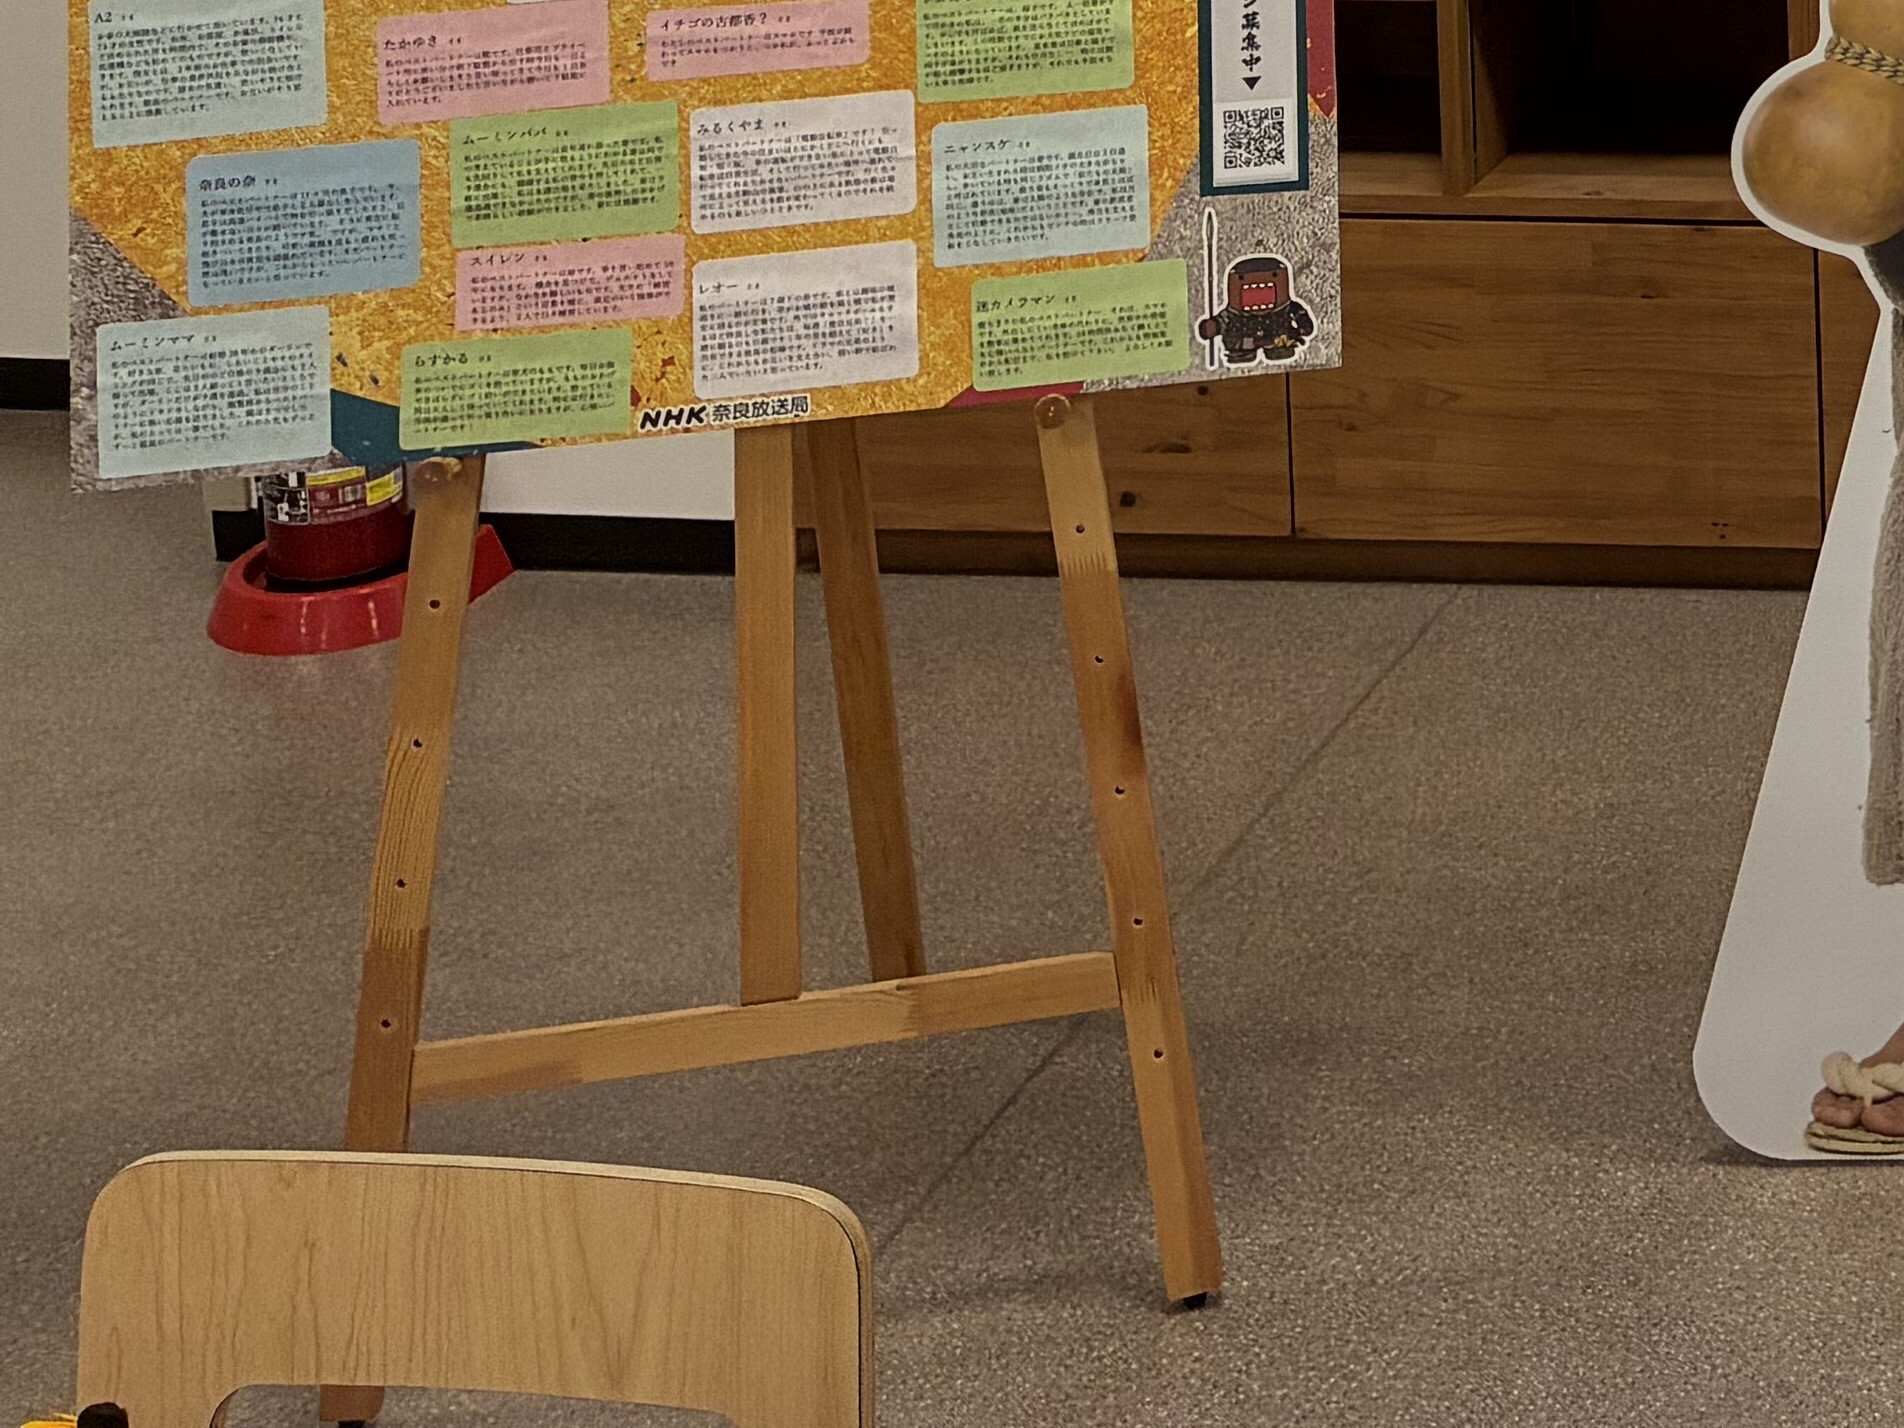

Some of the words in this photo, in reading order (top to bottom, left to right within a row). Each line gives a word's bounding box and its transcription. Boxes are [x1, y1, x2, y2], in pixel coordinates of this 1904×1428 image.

[94, 10, 113, 24] A2
[384, 35, 439, 51] たかゆき
[470, 252, 525, 267] スイレン
[639, 405, 708, 431] NHK
[711, 395, 811, 422] 奈良放送局
